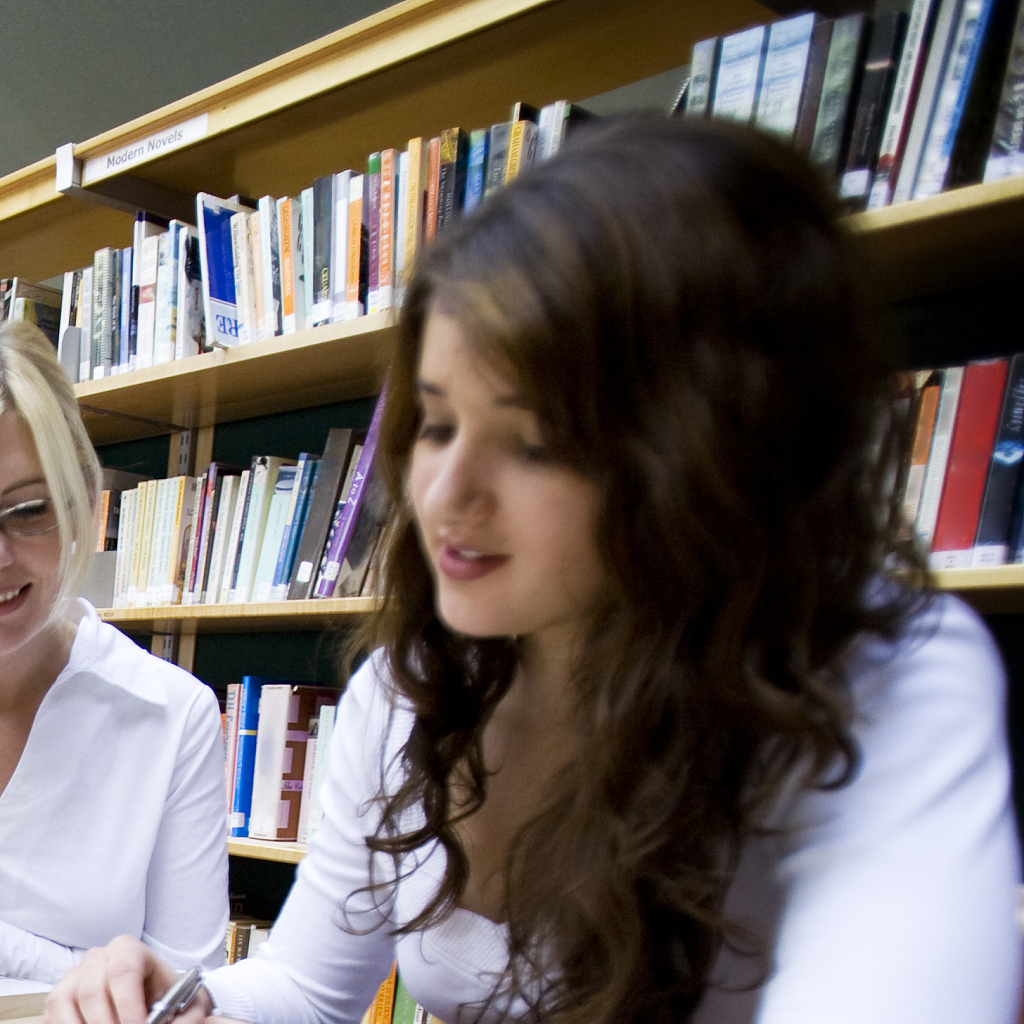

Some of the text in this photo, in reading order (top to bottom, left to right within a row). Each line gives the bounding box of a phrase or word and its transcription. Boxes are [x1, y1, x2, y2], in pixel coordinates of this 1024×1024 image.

[106, 130, 183, 168] Modern Novels
[347, 471, 363, 505] A to Z
